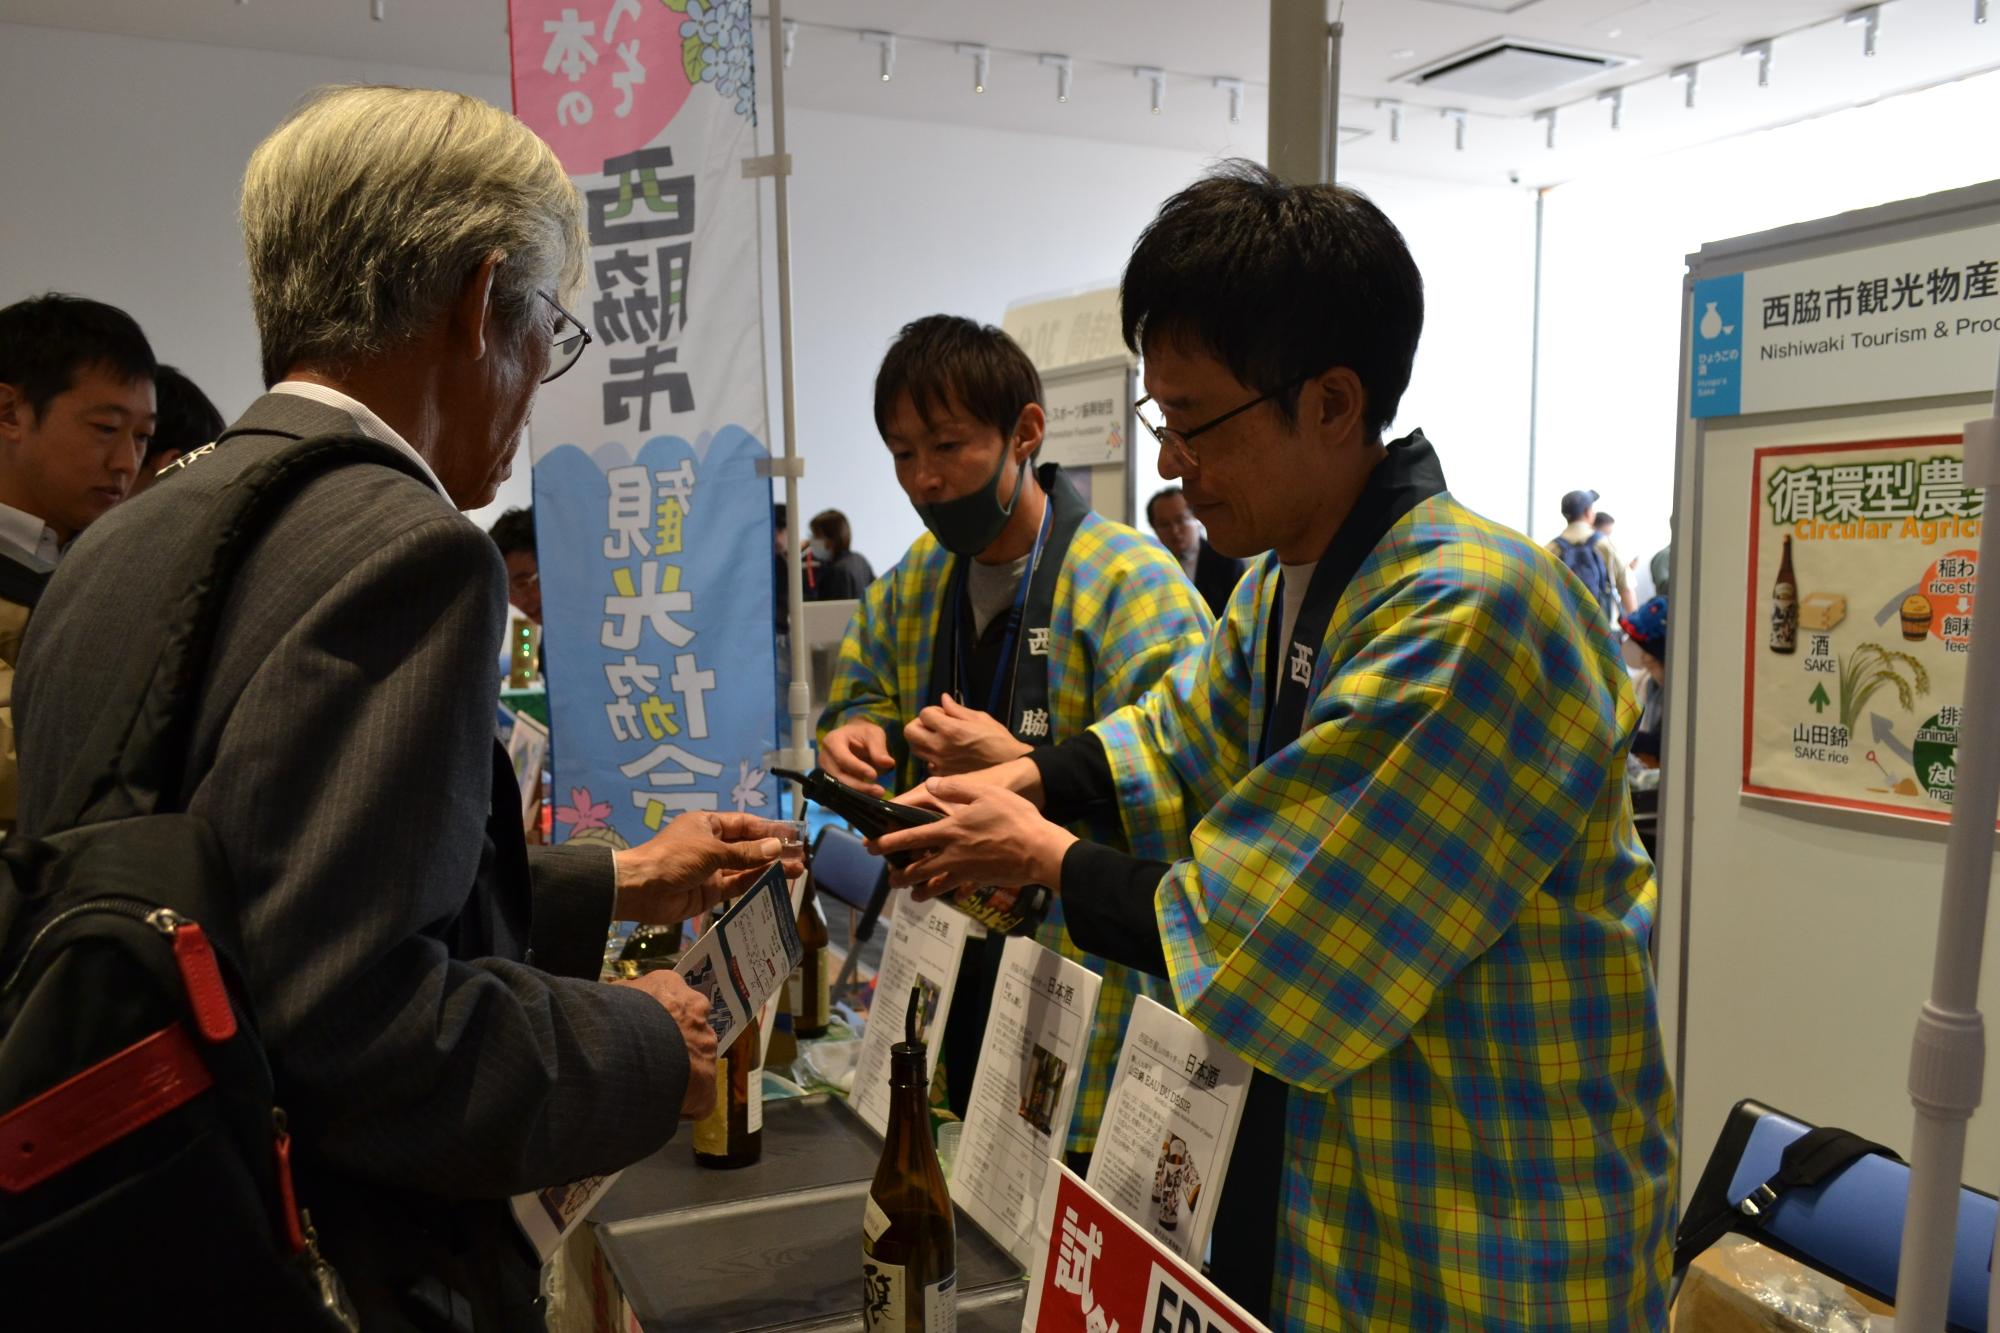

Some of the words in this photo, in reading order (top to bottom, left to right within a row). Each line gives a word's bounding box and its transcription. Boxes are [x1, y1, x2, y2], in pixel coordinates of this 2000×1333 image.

[1763, 260, 1999, 330] 西脇市観光物産
[1760, 335, 1845, 361] Nishiwaki
[1852, 325, 1927, 350] Tourism
[1934, 321, 1949, 339] &
[1793, 516, 1893, 541] Circular
[1929, 582, 1955, 594] rice
[1959, 581, 1976, 594] st
[1811, 635, 1829, 656] 酒
[1291, 641, 1314, 690] 西
[1803, 659, 1836, 673] SAKE
[1793, 723, 1849, 748] 山田錦
[1916, 727, 1958, 743] animal
[1794, 746, 1826, 761] SAKE
[1827, 750, 1849, 764] rice
[1047, 976, 1075, 1006] 日本酒
[1185, 1053, 1222, 1090] 日本酒
